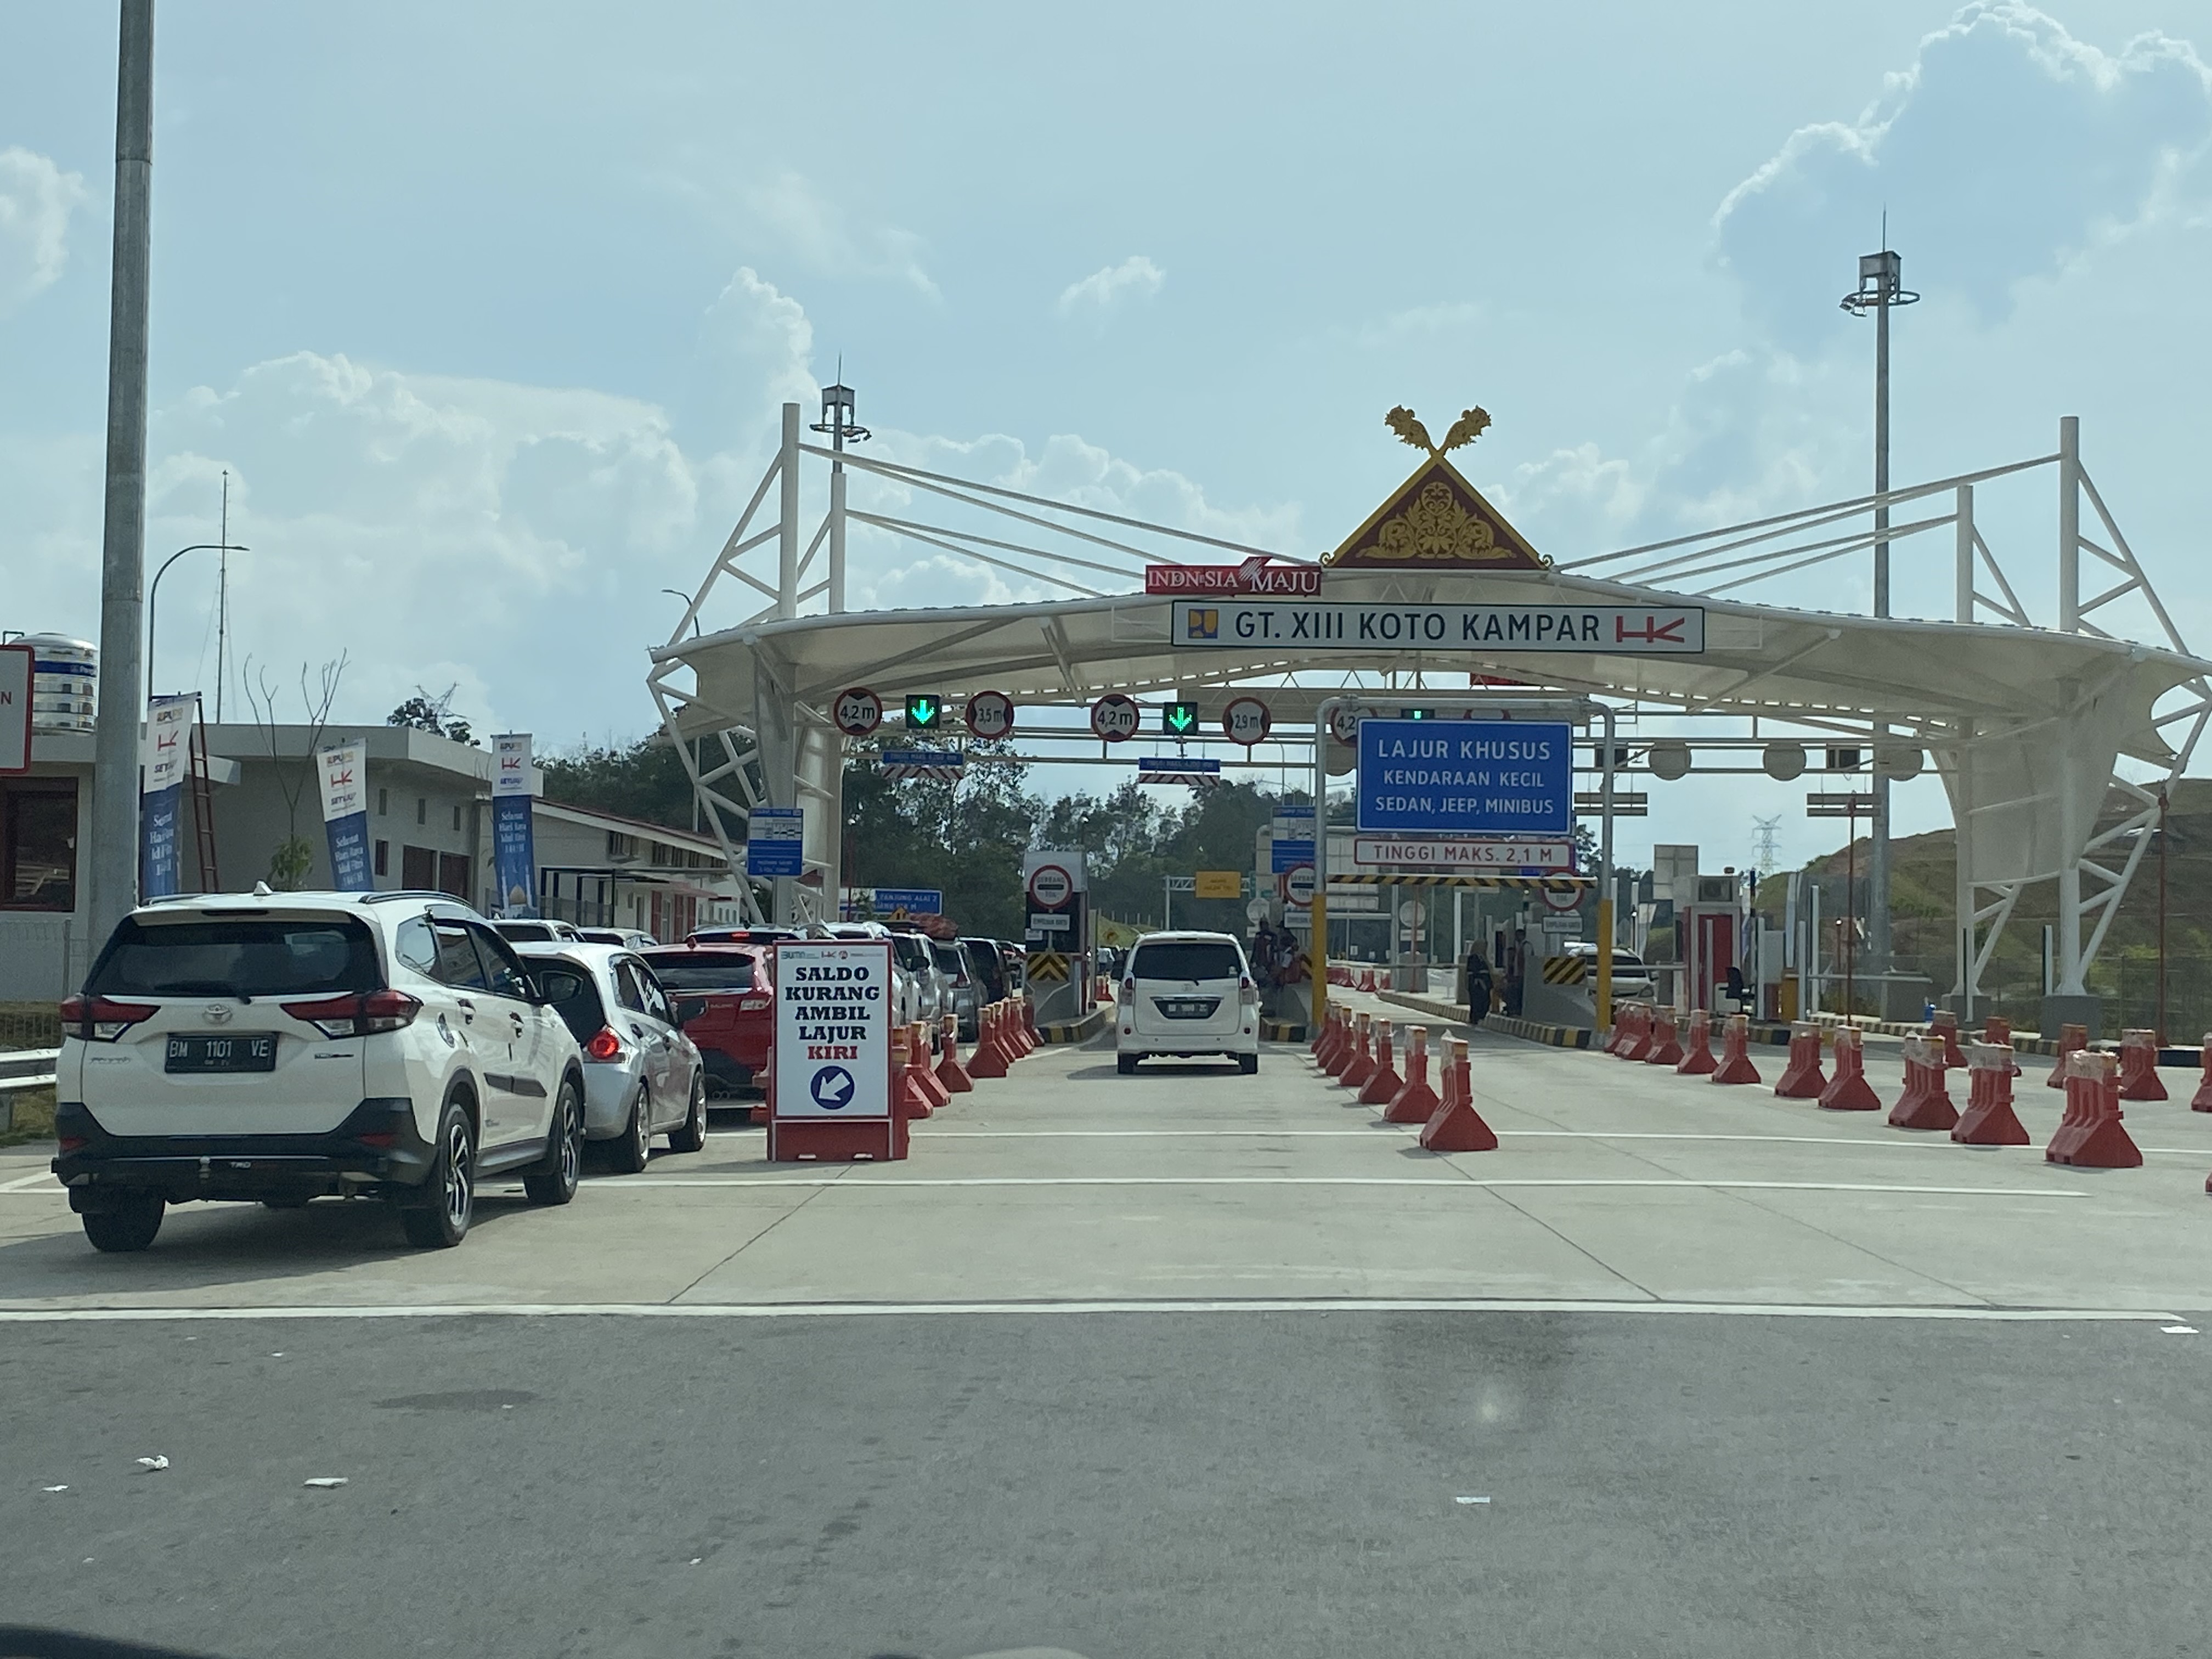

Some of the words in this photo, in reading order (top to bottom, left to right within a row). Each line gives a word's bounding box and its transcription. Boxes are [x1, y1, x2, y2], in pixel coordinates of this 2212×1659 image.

[1249, 569, 1320, 592] MAJU
[1235, 611, 1280, 638] GT.
[1291, 612, 1343, 639] XIII
[1360, 612, 1446, 640] KOTO
[1462, 614, 1600, 641] KAMPAR
[839, 704, 859, 723] 4,2
[862, 707, 875, 719] m
[978, 708, 992, 724] 3,5
[994, 710, 1003, 723] m
[1097, 710, 1116, 727] 4,2
[1120, 713, 1132, 725] m
[1235, 714, 1248, 731] 2,9
[1250, 716, 1259, 729] m
[1336, 715, 1356, 733] 4,2
[1378, 739, 1449, 759] LAJUR
[1460, 741, 1550, 760] KHUSUS
[1384, 770, 1490, 786] KENDARAAN
[1499, 771, 1545, 787] KECIL
[1375, 797, 1436, 815] SEDAN,
[1440, 798, 1480, 815] JEEP,
[1486, 798, 1554, 814] MINIBUS
[1374, 845, 1435, 861] TINGGI
[1444, 847, 1499, 862] MAKS.
[1506, 848, 1530, 864] 2,1
[1540, 848, 1552, 862] M
[795, 967, 870, 981] SALDO
[785, 986, 880, 1001] KURANG
[795, 1006, 871, 1020] AMBIL
[799, 1026, 867, 1043] LAJUR
[169, 1040, 188, 1058] BM
[251, 1039, 269, 1057] VE
[808, 1046, 858, 1059] KIRI
